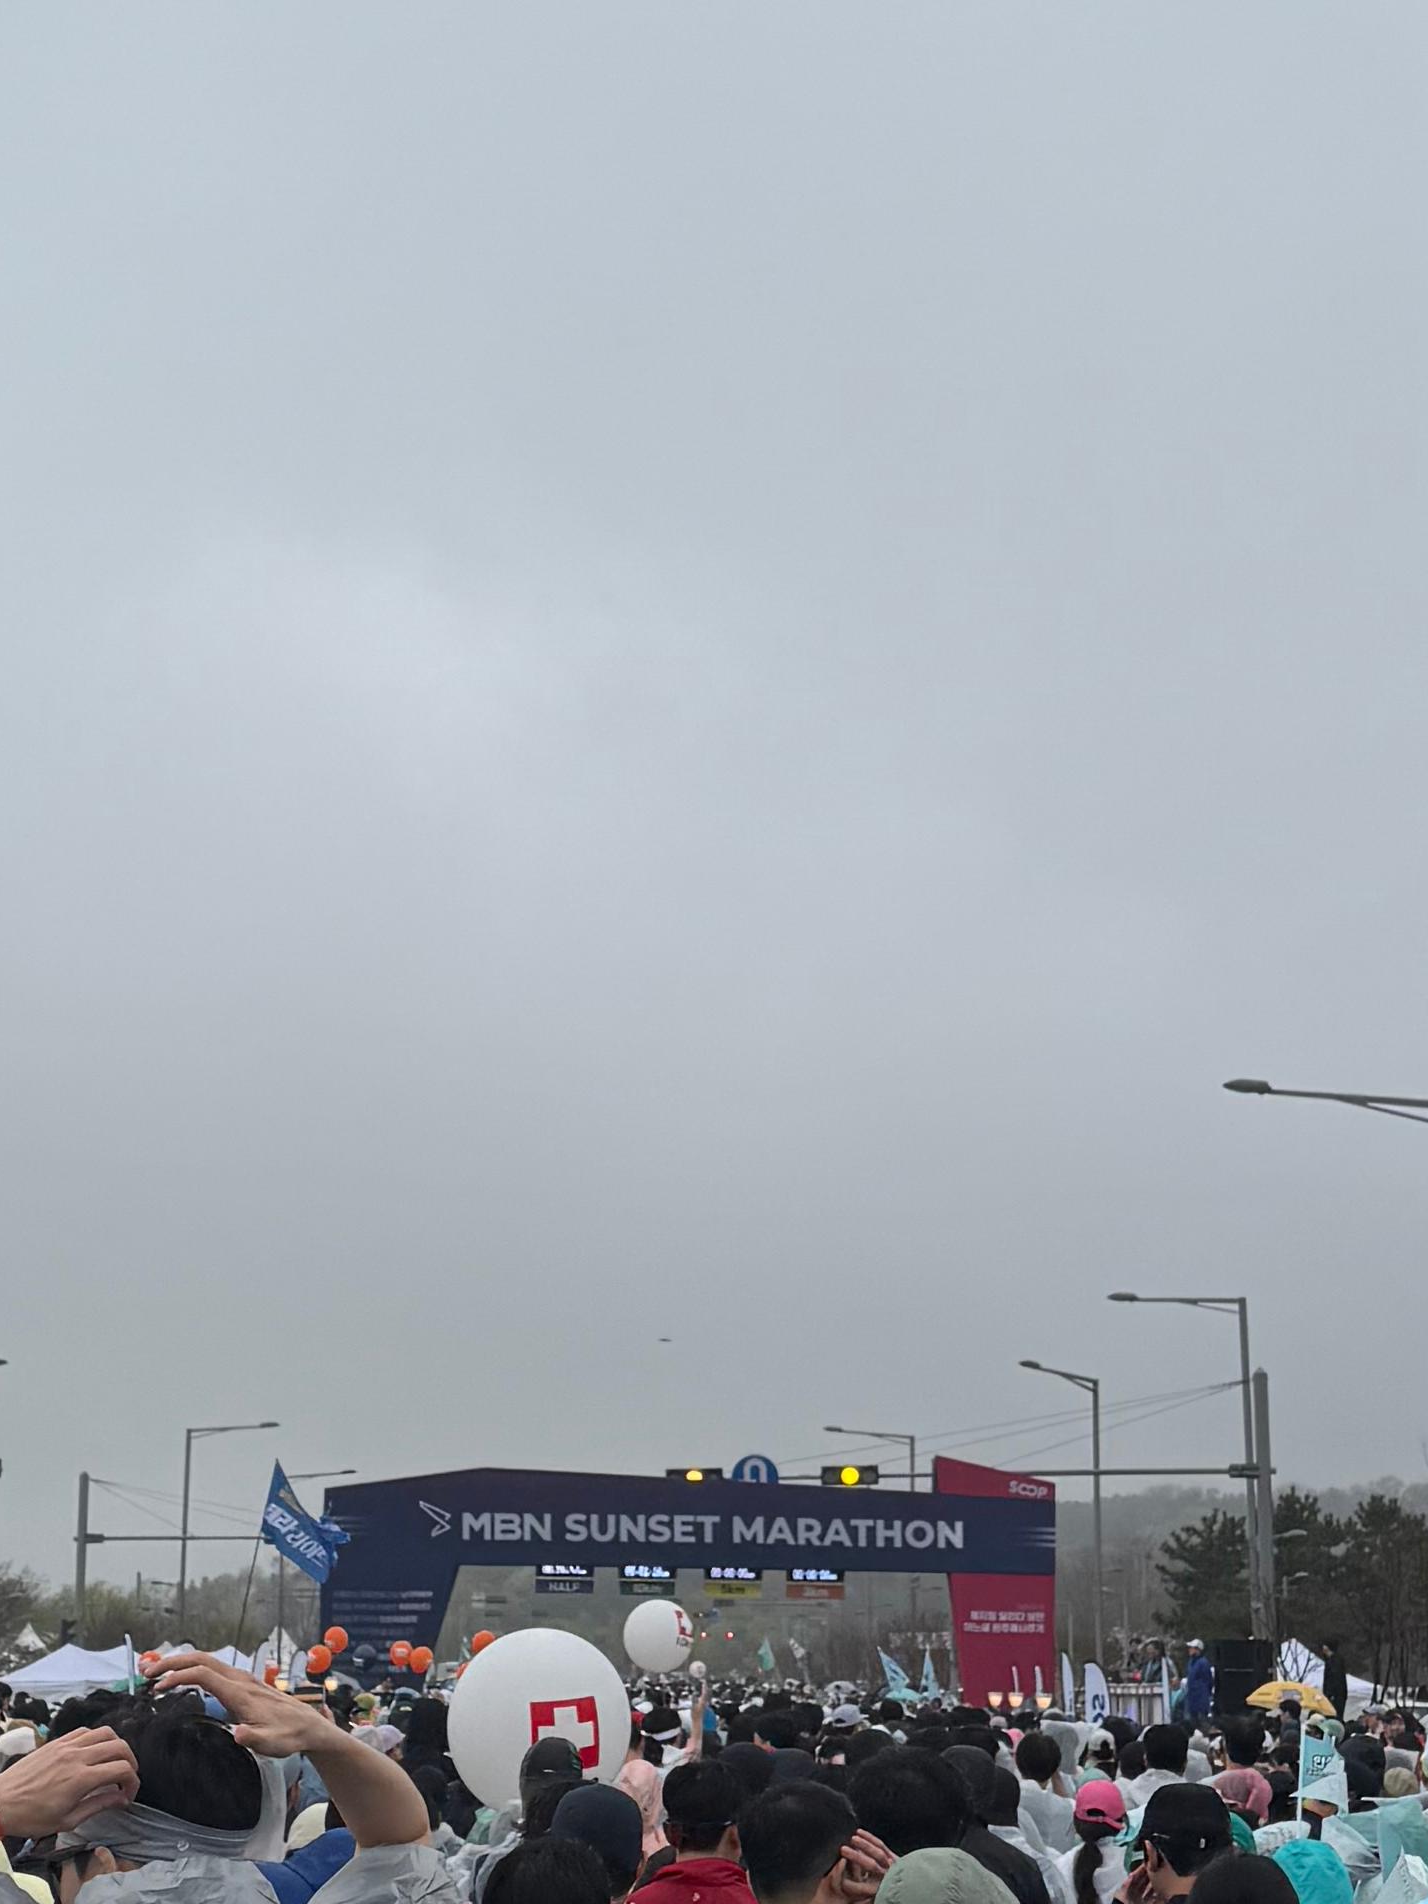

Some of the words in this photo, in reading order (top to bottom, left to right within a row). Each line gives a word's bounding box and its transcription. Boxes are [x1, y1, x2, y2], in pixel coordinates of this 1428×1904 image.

[461, 1511, 552, 1542] MBN
[564, 1512, 721, 1544] SUNSET
[731, 1514, 965, 1550] MARATHON
